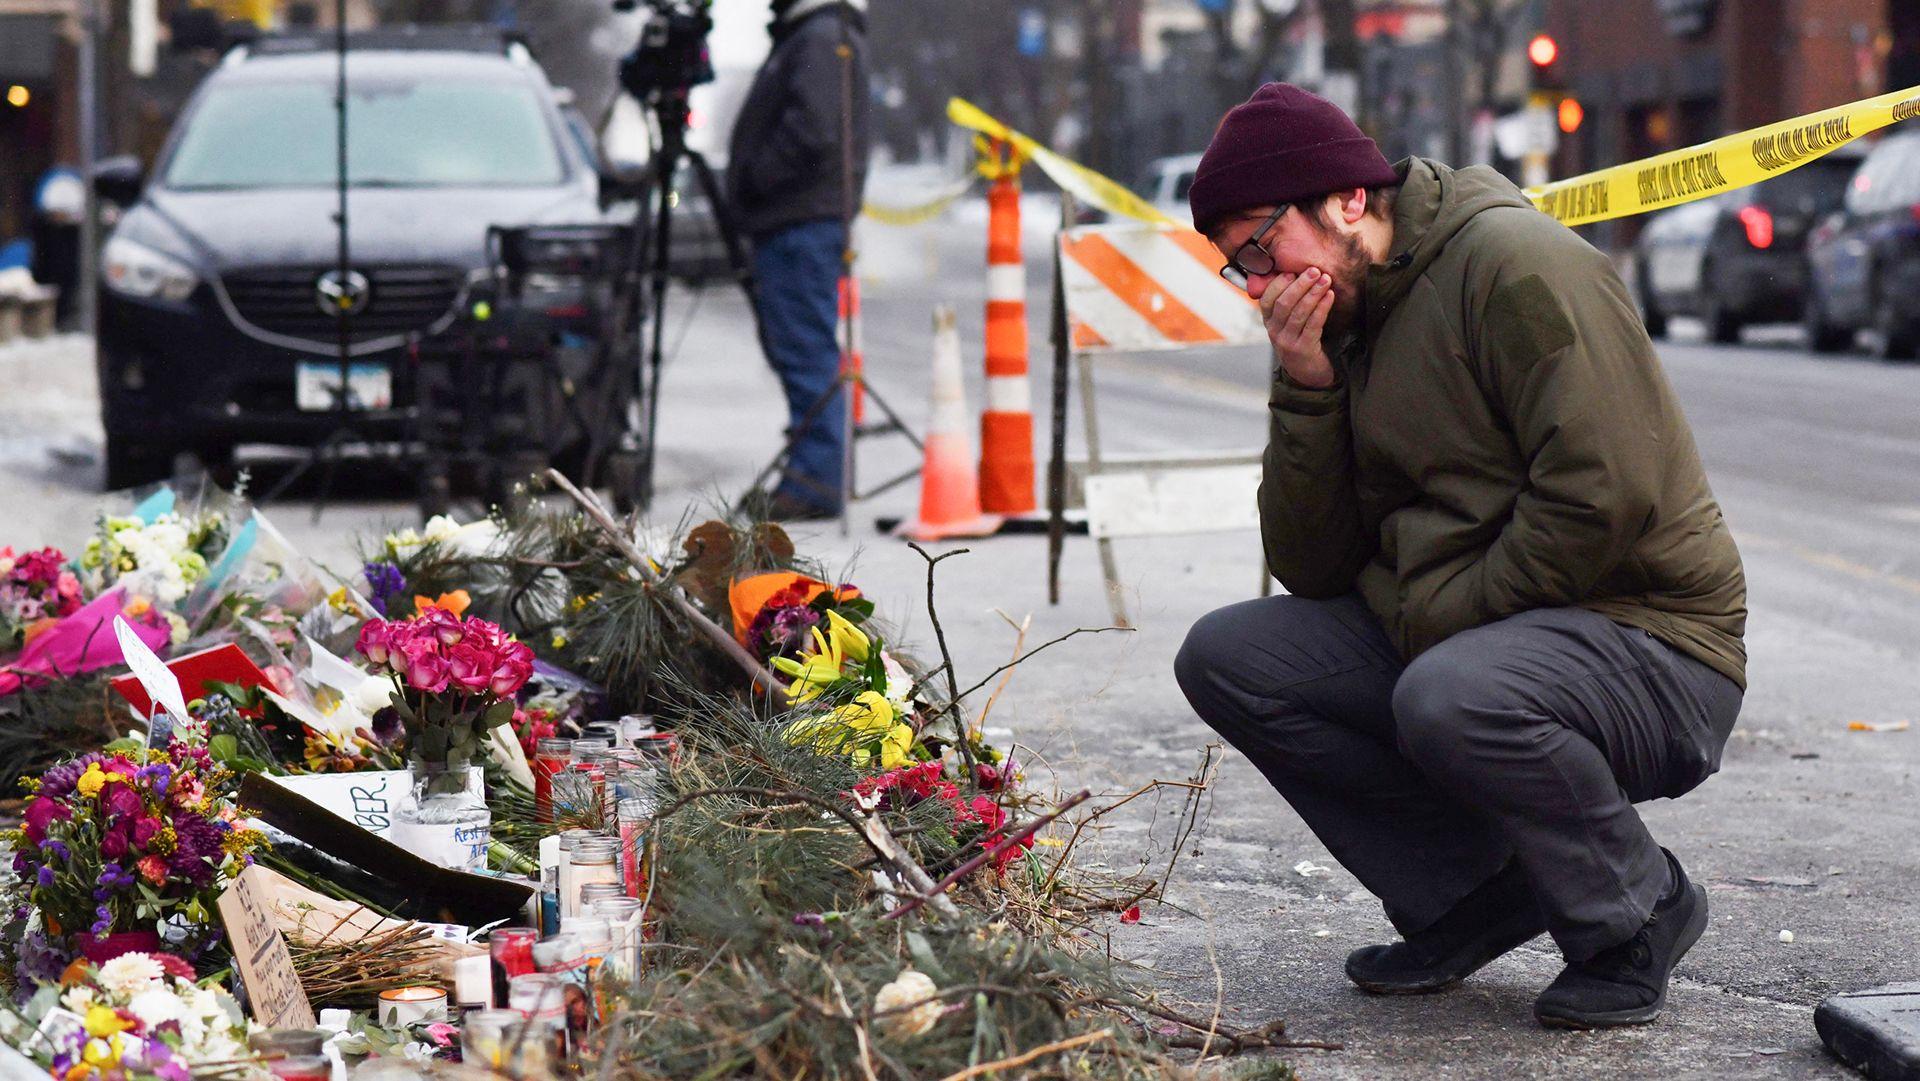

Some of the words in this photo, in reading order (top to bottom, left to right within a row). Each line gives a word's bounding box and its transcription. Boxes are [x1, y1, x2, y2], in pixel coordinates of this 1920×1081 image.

[1793, 127, 1810, 157] DO
[1671, 161, 1685, 197] DO
[350, 777, 391, 834] BER.
[454, 824, 480, 843] Rest
[470, 844, 489, 859] Ale
